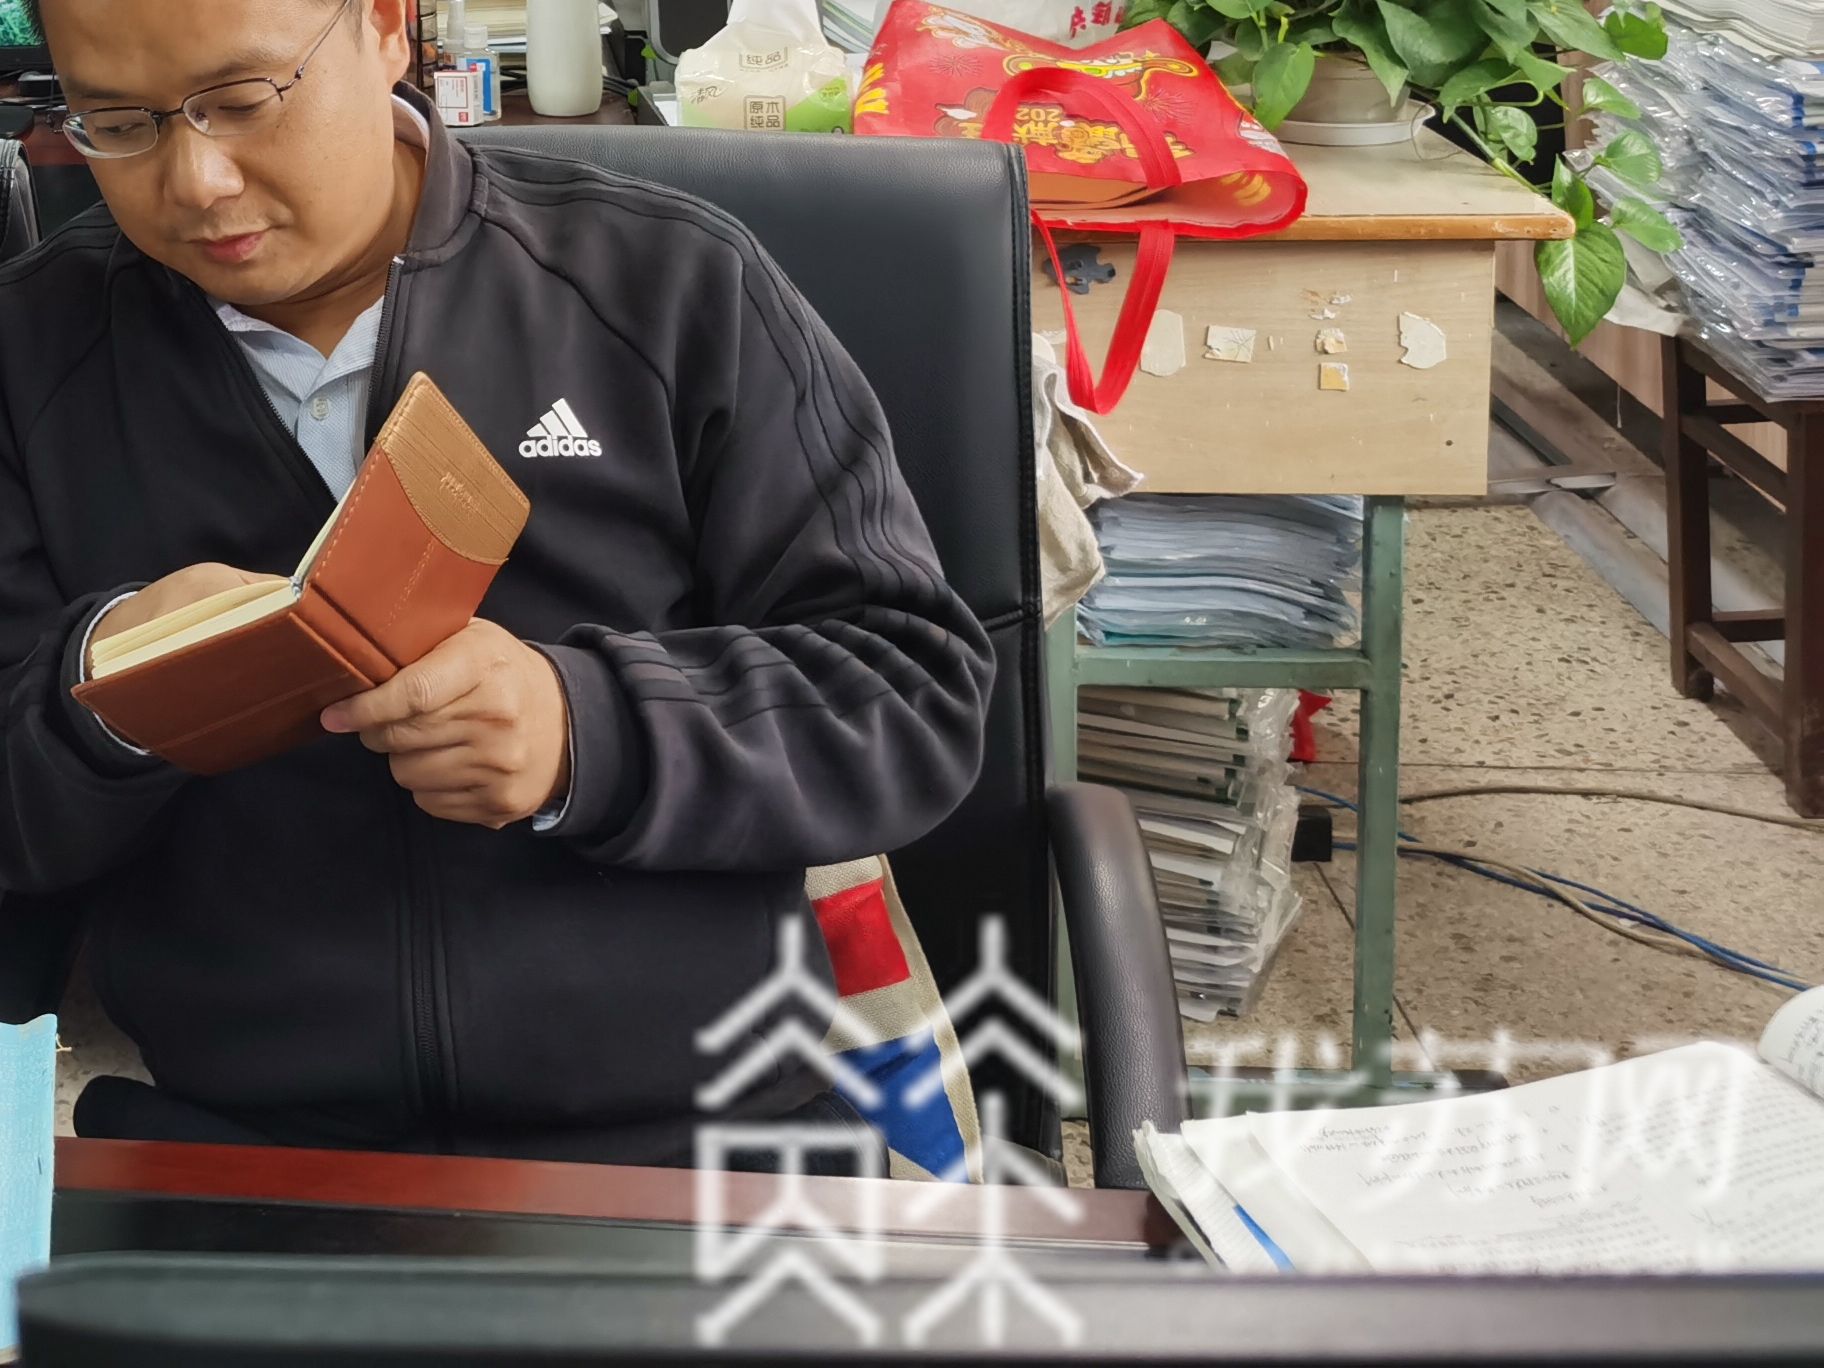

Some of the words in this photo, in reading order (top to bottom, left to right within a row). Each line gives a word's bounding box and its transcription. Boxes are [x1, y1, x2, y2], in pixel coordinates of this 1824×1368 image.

[746, 51, 782, 65] 纯品
[749, 100, 780, 114] 原木
[749, 115, 781, 129] 纯品
[1015, 107, 1061, 123] 202
[518, 435, 603, 458] adidas
